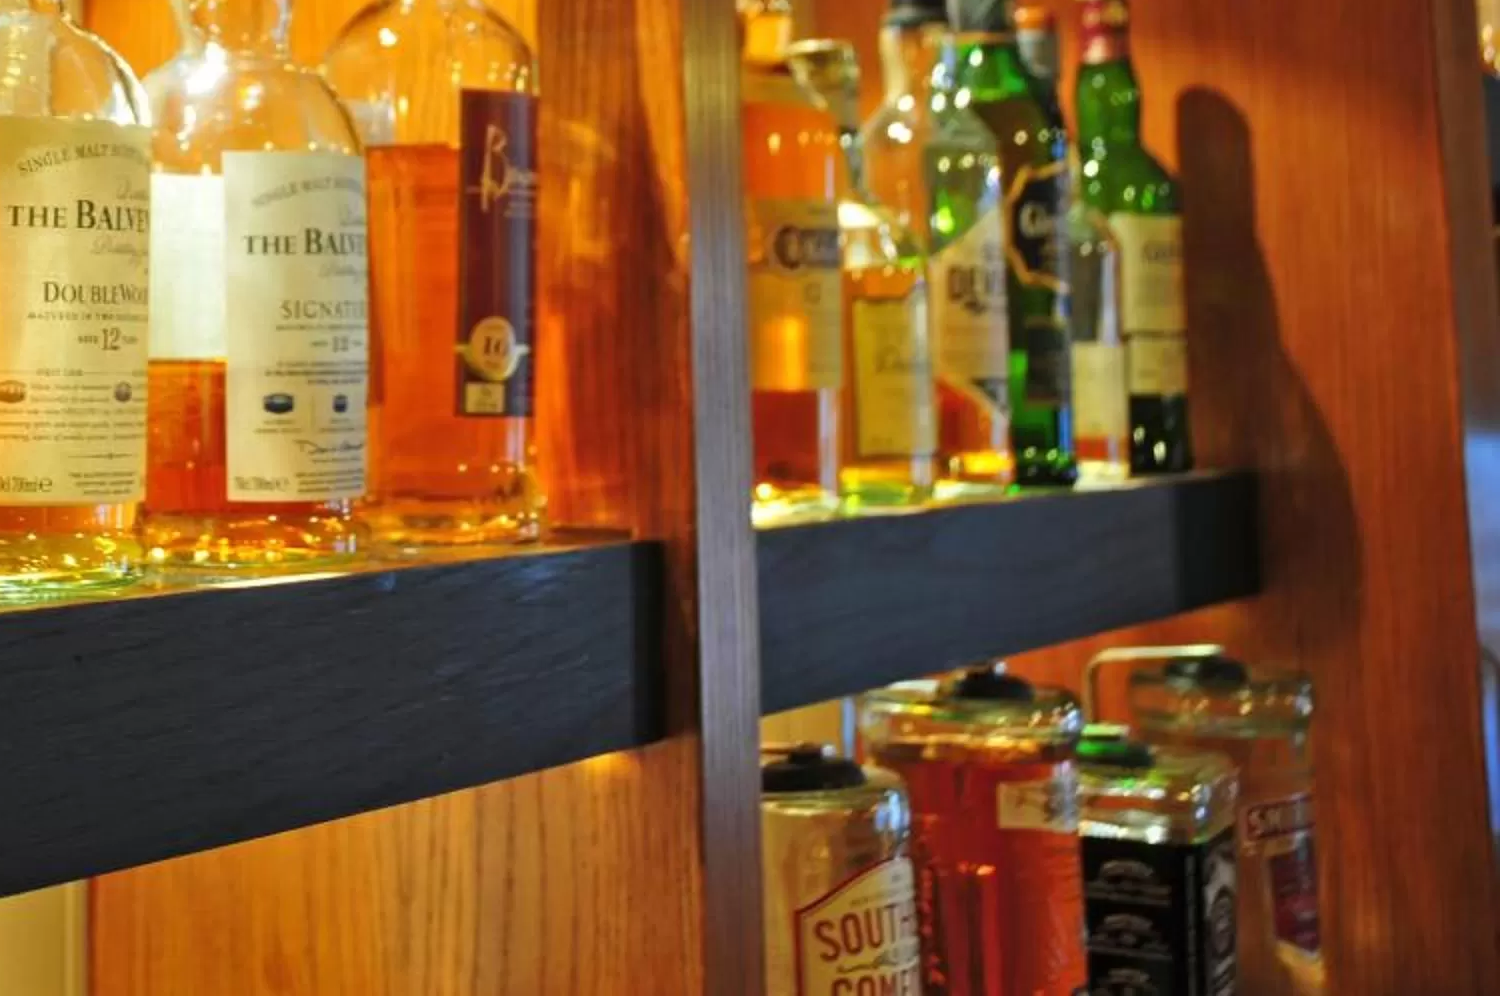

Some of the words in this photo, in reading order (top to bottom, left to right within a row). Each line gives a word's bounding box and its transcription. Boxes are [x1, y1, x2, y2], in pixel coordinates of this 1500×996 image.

[6, 205, 68, 228] THE
[242, 234, 298, 255] THE
[101, 327, 122, 351] 12
